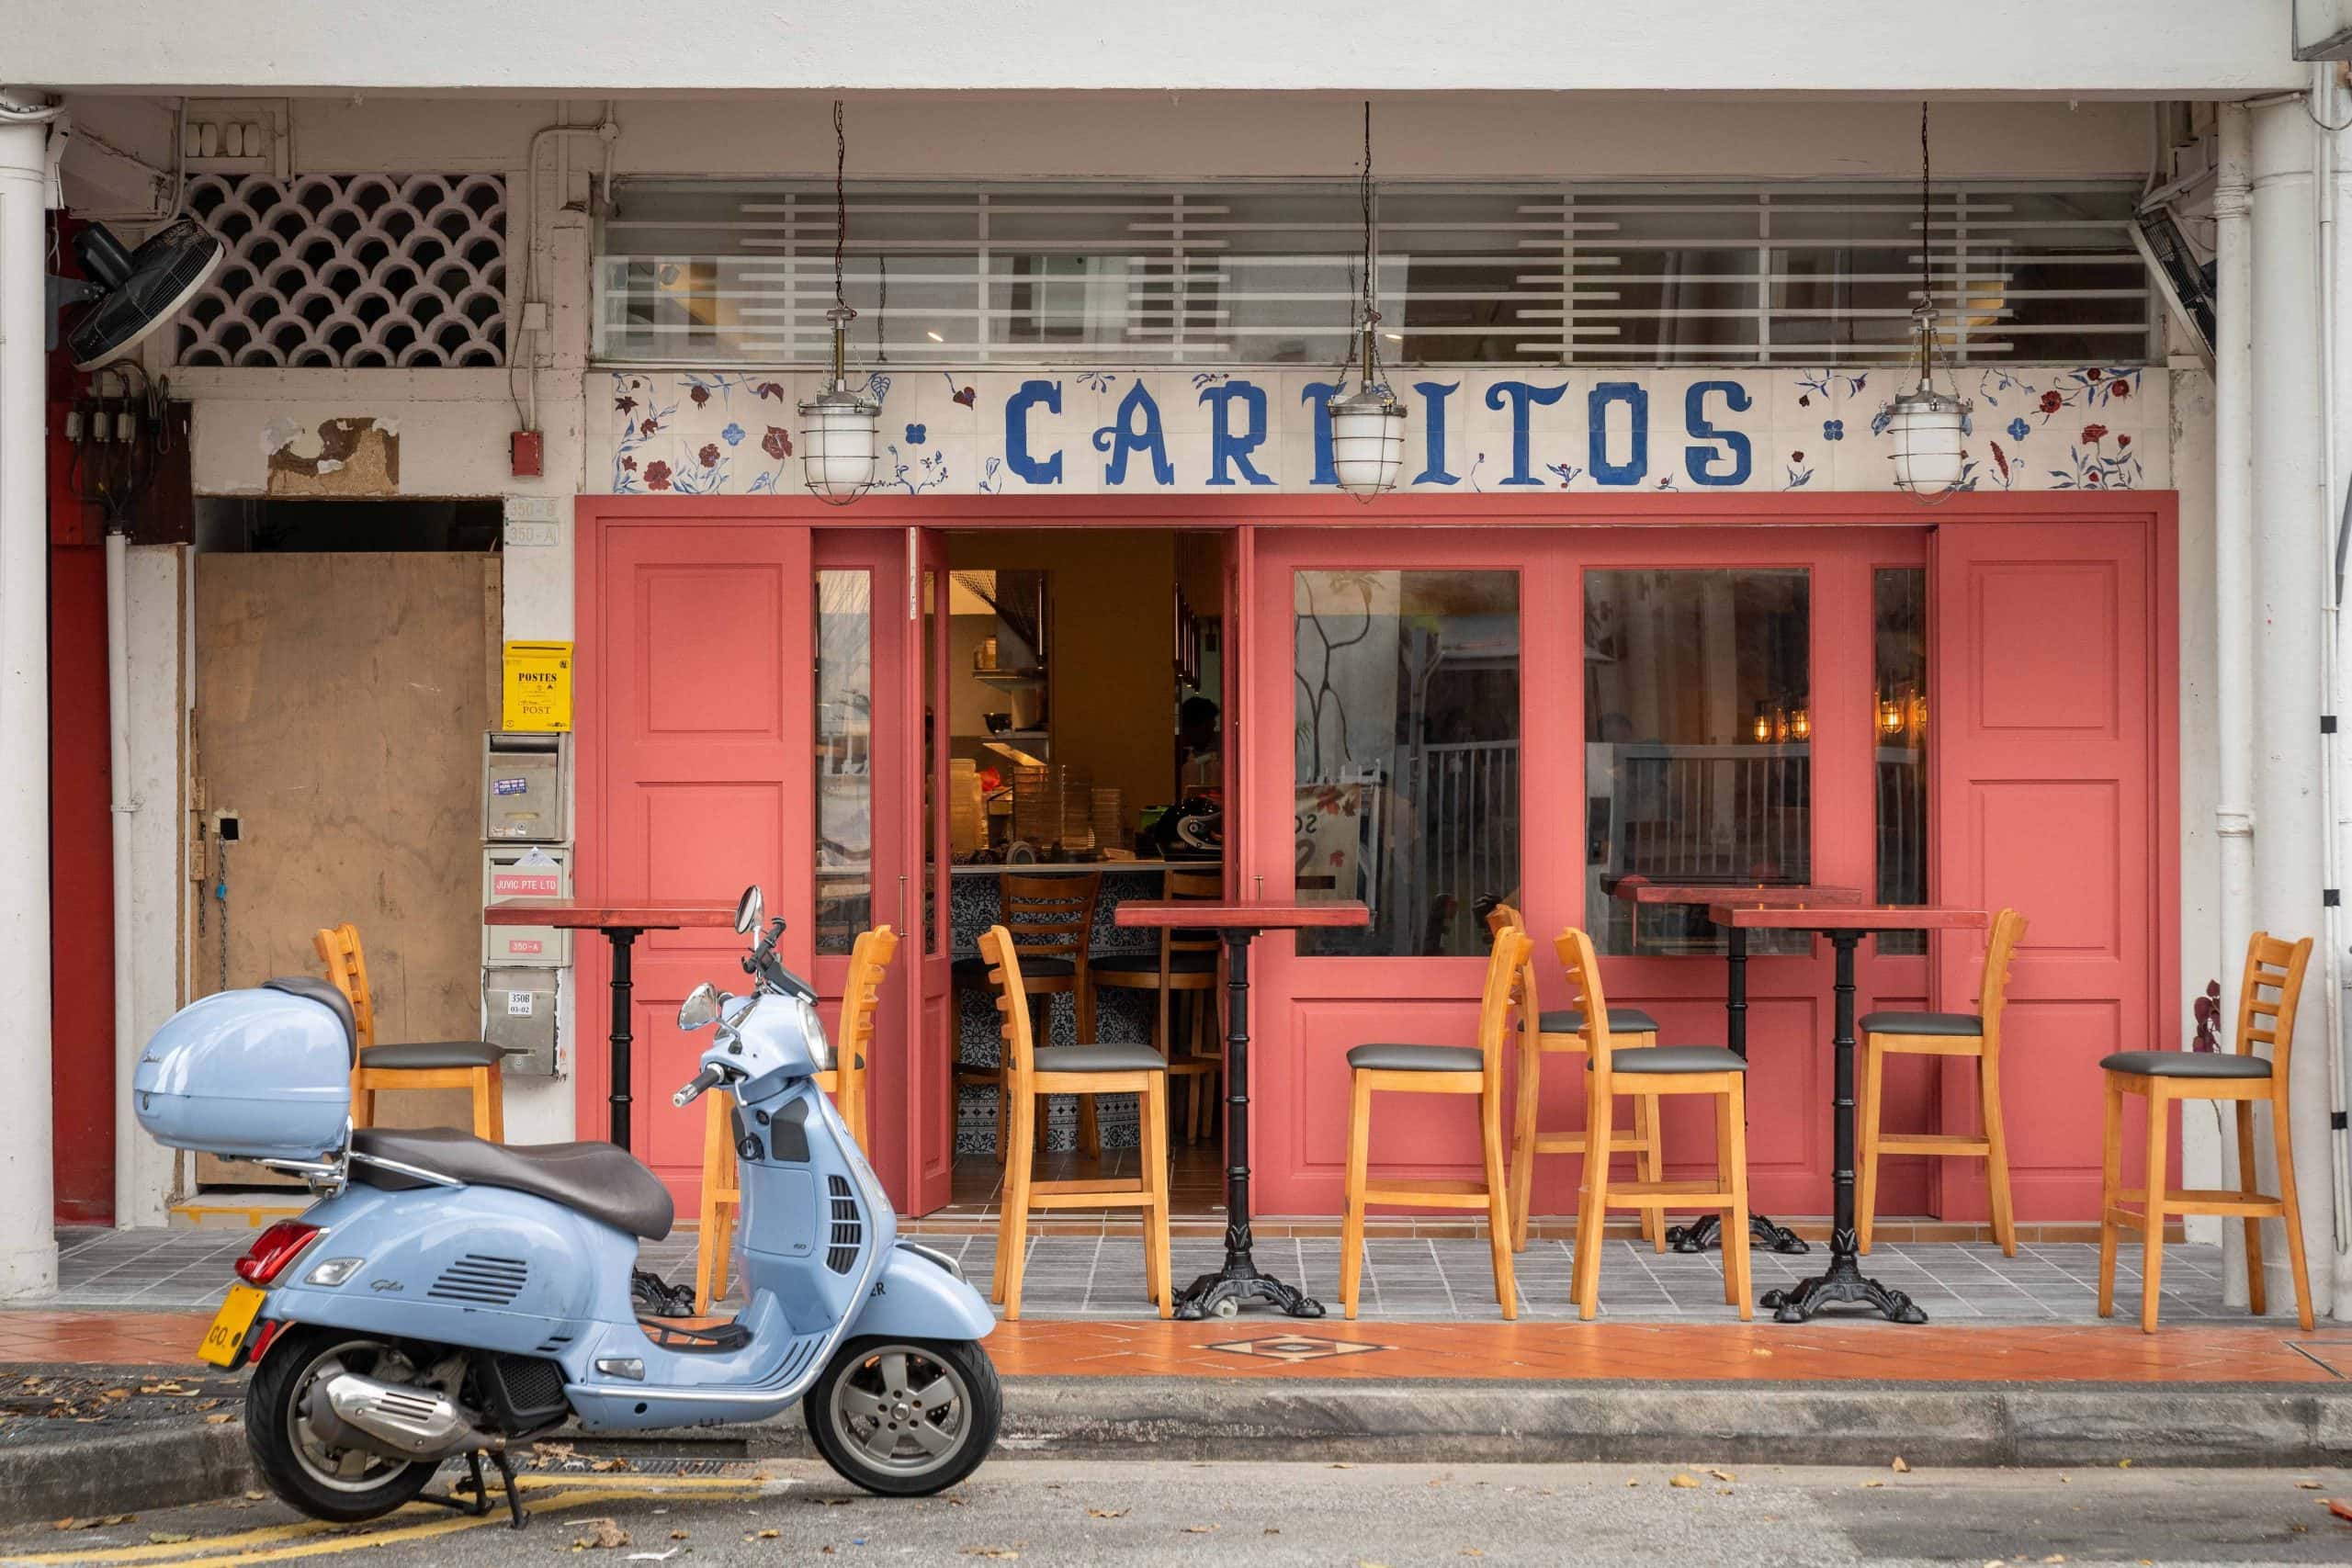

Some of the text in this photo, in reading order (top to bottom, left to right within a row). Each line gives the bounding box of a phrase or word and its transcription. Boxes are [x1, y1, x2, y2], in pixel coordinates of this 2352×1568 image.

[518, 672, 557, 682] POSTES
[523, 705, 551, 714] POST
[496, 880, 556, 890] JUVIC PTE LTD
[511, 994, 530, 1003] 350B
